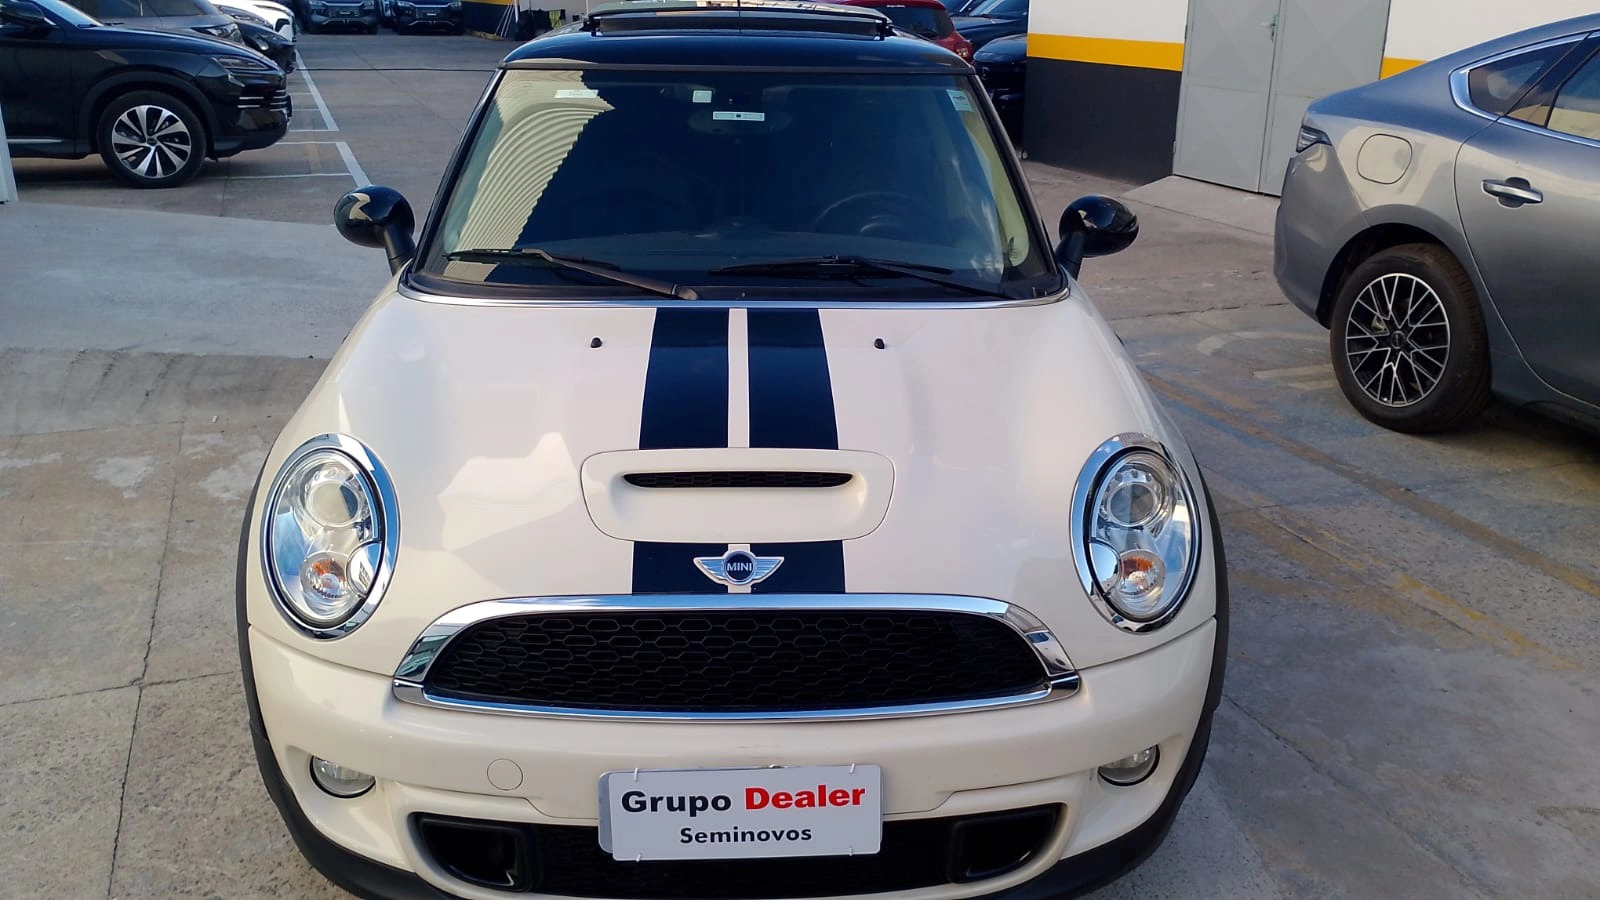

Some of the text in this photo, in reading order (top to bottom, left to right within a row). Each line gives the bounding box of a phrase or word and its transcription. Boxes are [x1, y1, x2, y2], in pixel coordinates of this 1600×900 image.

[727, 562, 752, 572] MINI
[622, 784, 866, 817] Grupo Dealer
[680, 827, 813, 844] Seminovos
